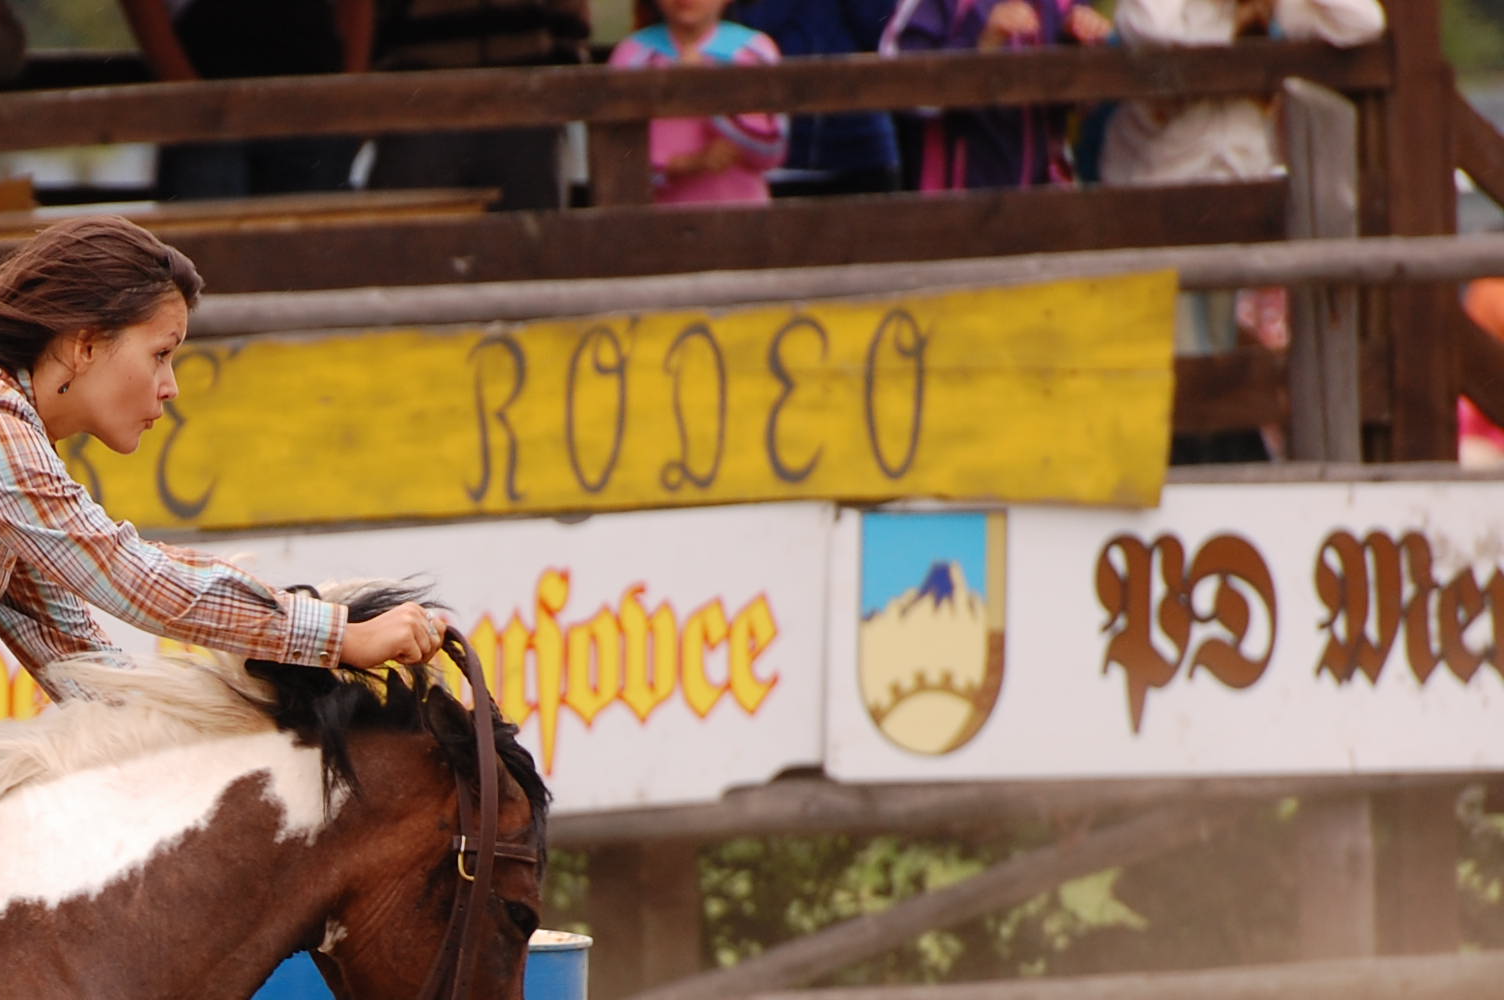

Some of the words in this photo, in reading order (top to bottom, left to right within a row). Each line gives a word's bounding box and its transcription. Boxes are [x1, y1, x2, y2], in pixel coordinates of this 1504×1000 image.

[464, 308, 933, 503] RODEO
[1093, 530, 1278, 735] PD
[1314, 525, 1504, 686] Me
